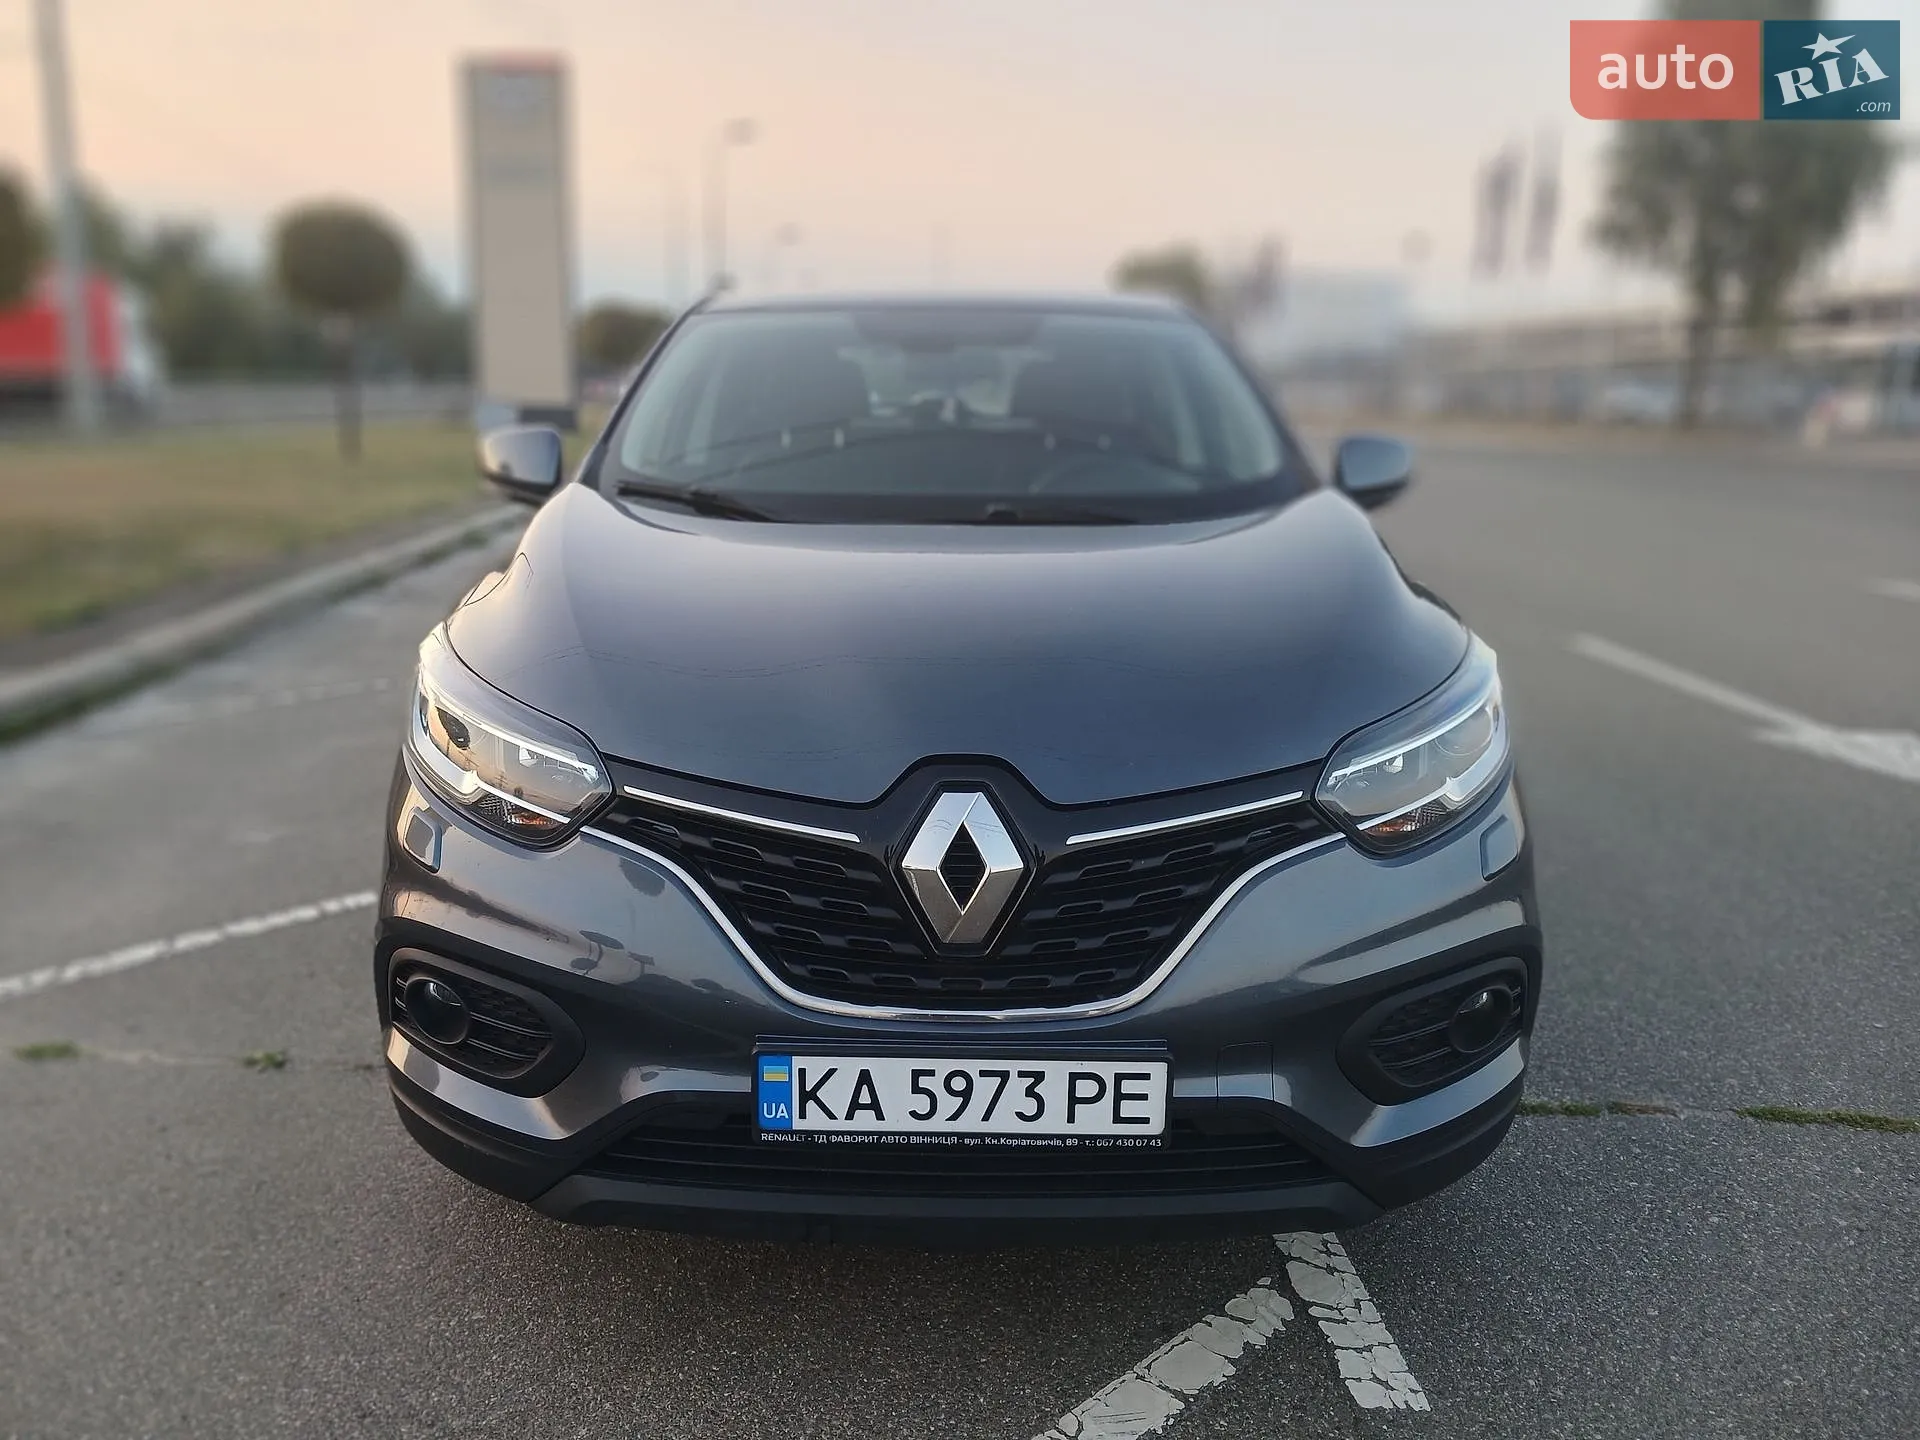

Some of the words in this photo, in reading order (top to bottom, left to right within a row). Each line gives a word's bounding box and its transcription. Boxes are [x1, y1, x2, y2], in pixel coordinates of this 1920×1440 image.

[797, 1066, 886, 1122] KA
[908, 1068, 1046, 1123] 5973
[1066, 1071, 1152, 1125] PE
[763, 1102, 789, 1120] UA
[761, 1133, 806, 1142] RENAULT
[813, 1134, 827, 1144] ТД
[829, 1134, 879, 1144] ФАВОРИТ
[880, 1135, 908, 1144] АВТО
[909, 1135, 957, 1145] ВІННИЦЯ
